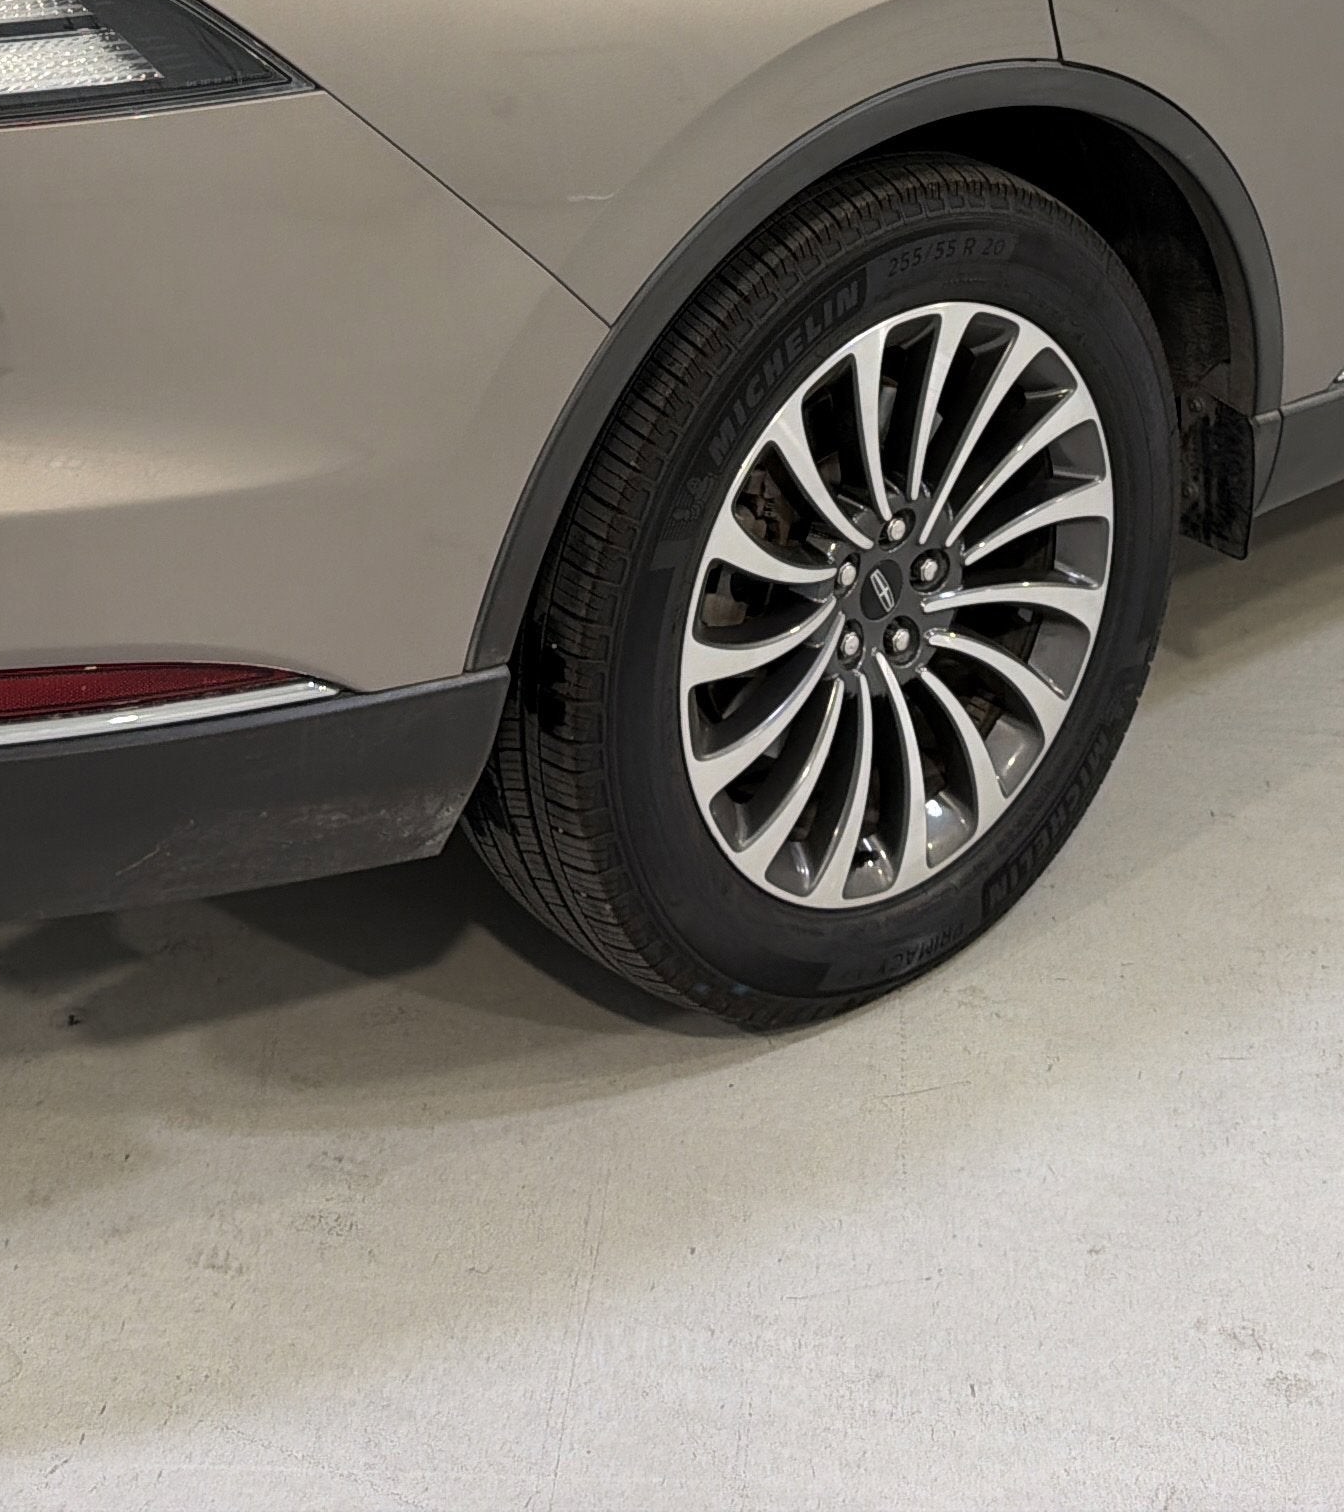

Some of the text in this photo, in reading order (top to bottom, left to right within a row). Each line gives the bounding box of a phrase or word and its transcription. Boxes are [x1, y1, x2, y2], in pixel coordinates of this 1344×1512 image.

[888, 237, 1006, 277] 255/55 R 20
[708, 280, 859, 467] MICHELIN
